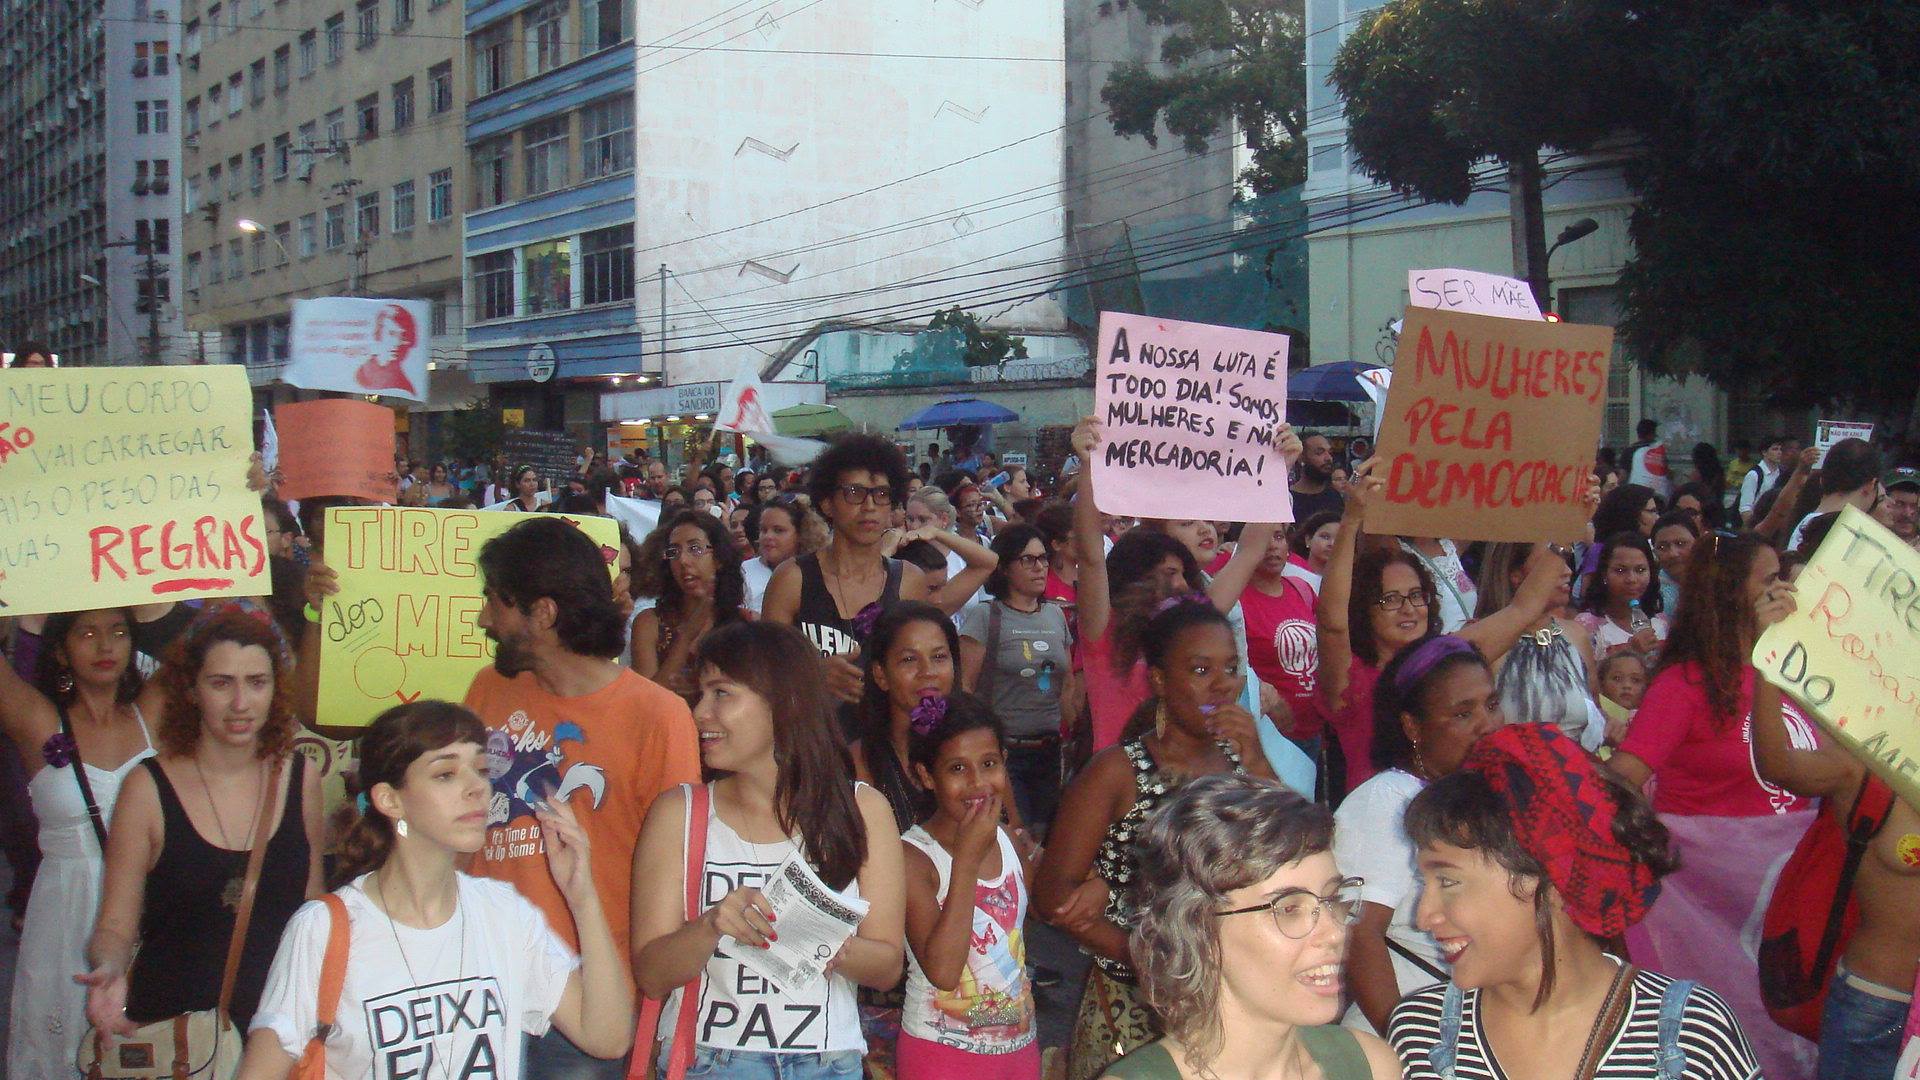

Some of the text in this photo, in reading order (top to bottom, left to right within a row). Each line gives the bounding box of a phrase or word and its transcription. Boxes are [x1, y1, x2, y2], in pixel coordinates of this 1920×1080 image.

[1415, 276, 1531, 314] SER MÃE
[1109, 327, 1280, 380] A NOSSA LUTA É
[1415, 325, 1604, 404] MULHERES
[8, 381, 212, 416] MEU CORPO
[678, 386, 715, 399] BANCA DO
[678, 398, 716, 412] SANDRO
[1106, 373, 1167, 399] TODO
[1175, 378, 1222, 405] DIA!
[1107, 401, 1215, 437] MULHERES
[1226, 421, 1244, 440] E
[1404, 396, 1512, 450] PELA
[85, 425, 233, 466] CARREGAR
[51, 486, 72, 516] O
[81, 474, 157, 512] PESO
[169, 471, 221, 500] DAS
[89, 515, 266, 582] REGRAS
[335, 509, 478, 578] TIRE
[327, 597, 384, 643] dos
[395, 594, 498, 659] ME
[1779, 640, 1836, 706] DO
[505, 826, 526, 843] Time
[529, 824, 540, 840] to
[509, 842, 536, 858] Some
[372, 987, 505, 1049] DEIXA
[702, 1001, 822, 1050] PAZ
